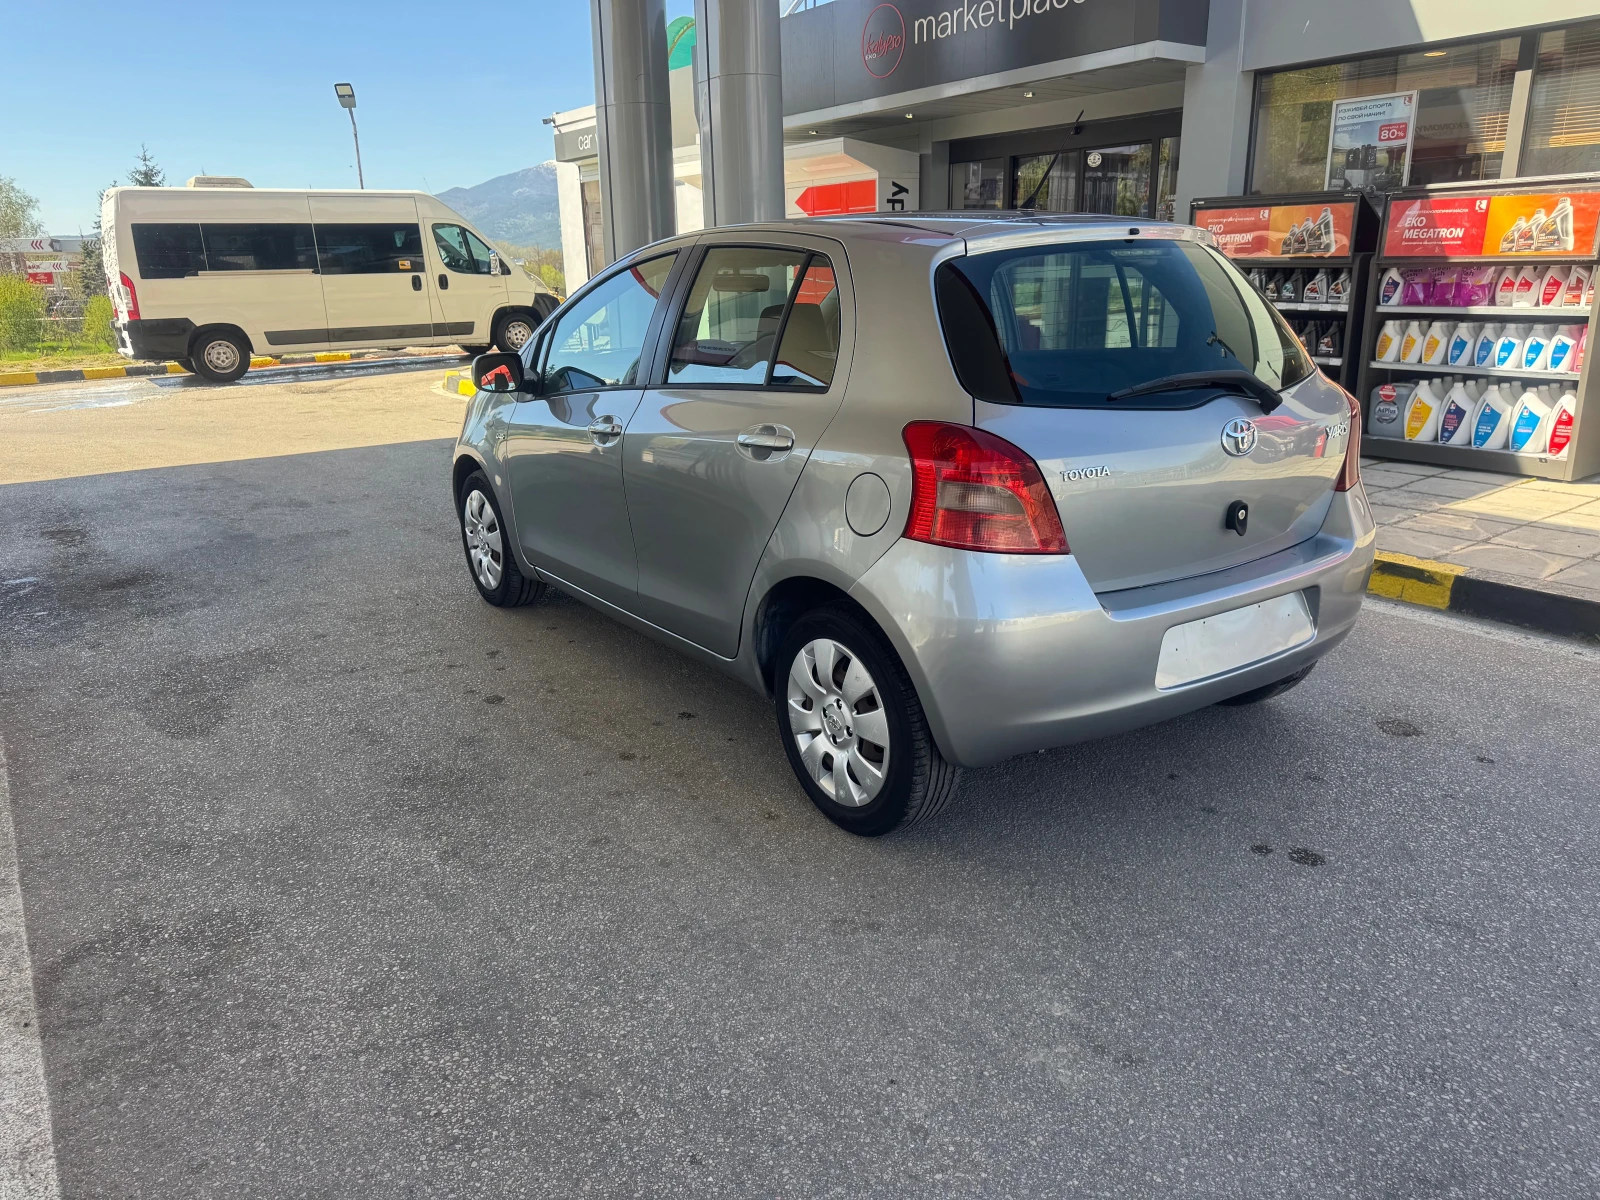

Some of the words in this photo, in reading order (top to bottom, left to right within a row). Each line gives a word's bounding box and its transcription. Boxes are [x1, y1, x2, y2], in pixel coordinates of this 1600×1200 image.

[914, 0, 1088, 44] marketp
[866, 31, 902, 58] kalypso
[1368, 102, 1393, 110] СПОРТА
[1380, 129, 1405, 140] 80%
[578, 134, 593, 150] car
[1404, 217, 1427, 227] EKO
[1216, 234, 1254, 243] GATRON
[1402, 227, 1465, 239] MEGATRON
[1060, 466, 1111, 482] TOYOTA
